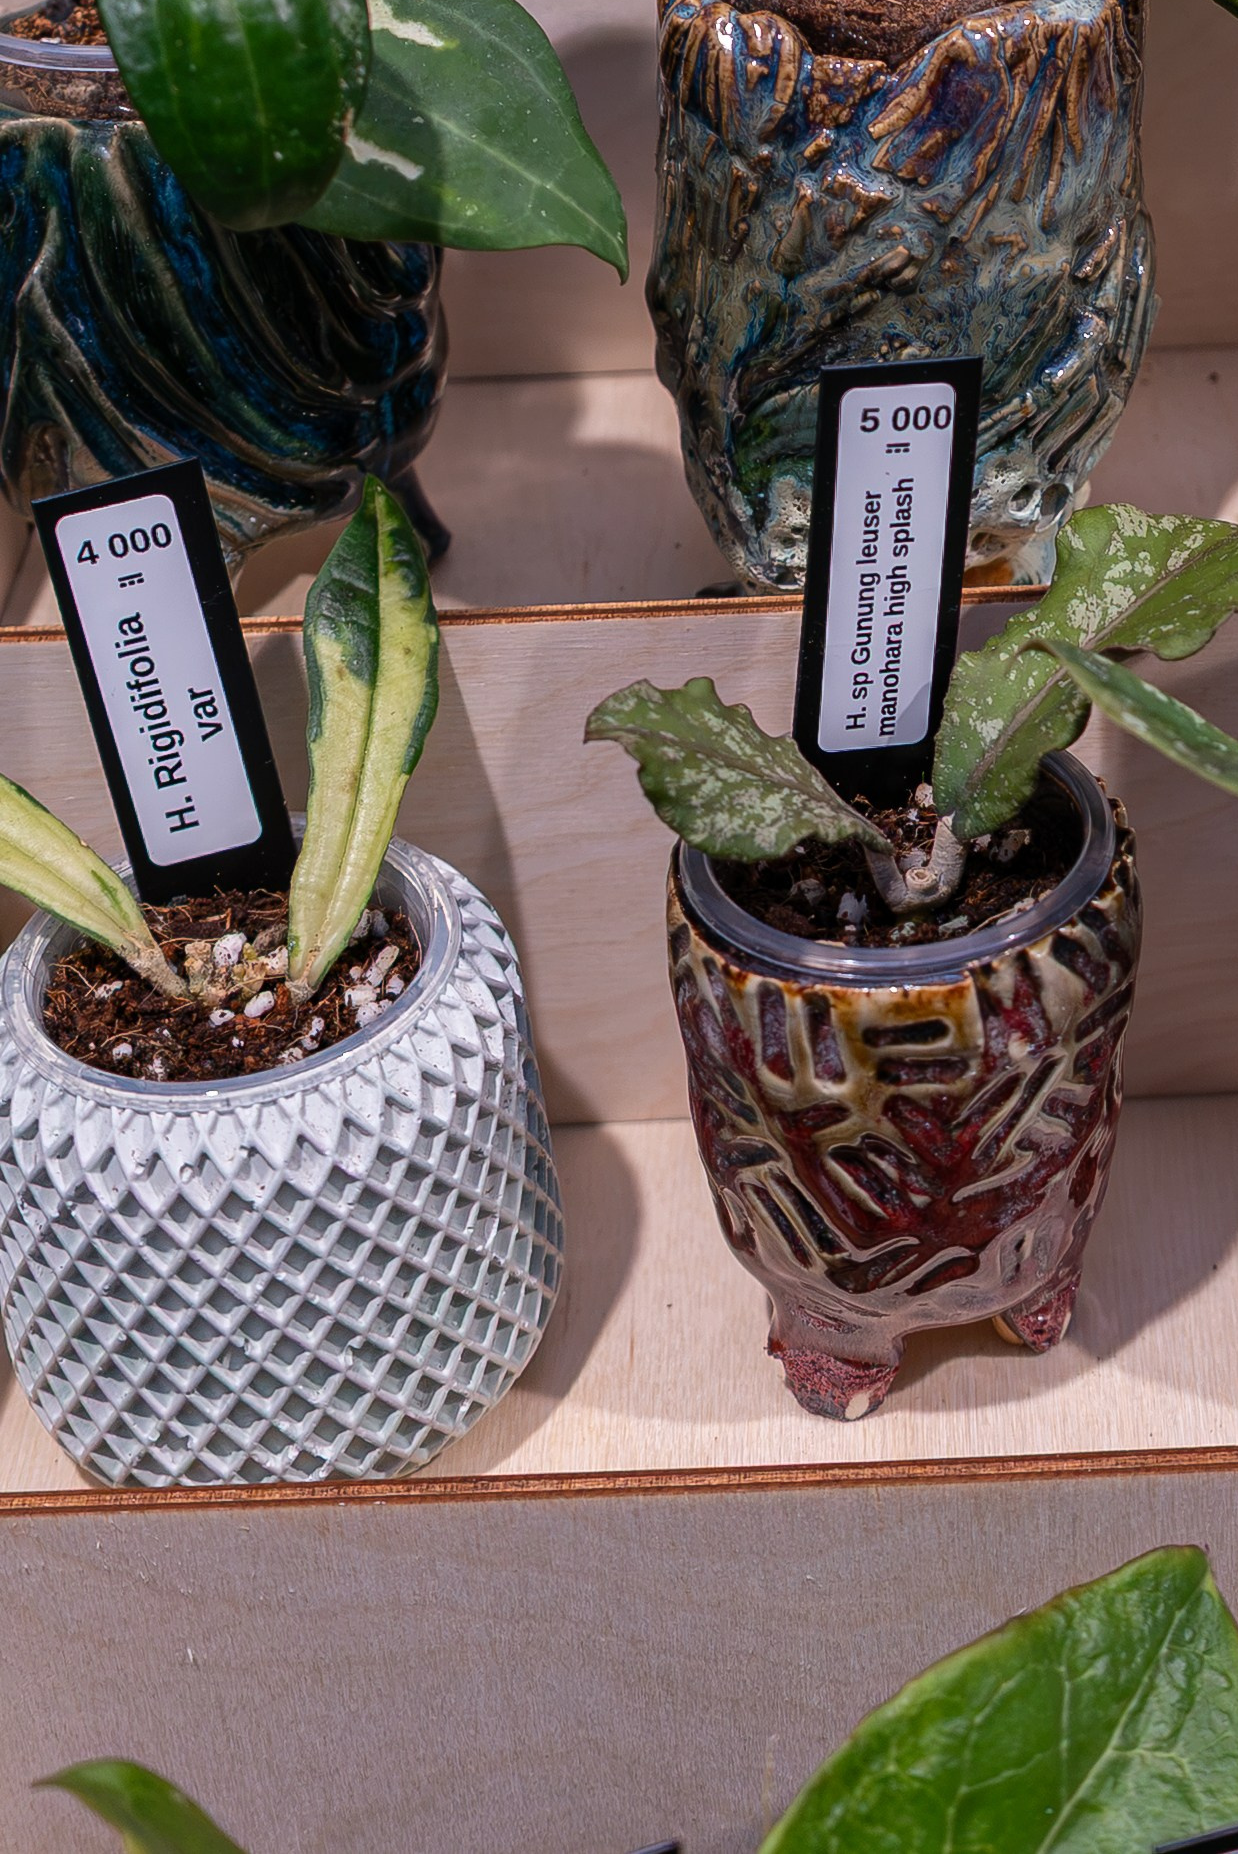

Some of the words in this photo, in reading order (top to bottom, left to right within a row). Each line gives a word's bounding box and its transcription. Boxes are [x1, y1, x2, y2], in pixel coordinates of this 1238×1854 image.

[860, 408, 880, 433] 5
[892, 405, 952, 432] 000
[77, 540, 99, 564] 4
[108, 523, 172, 558] 000
[856, 491, 881, 565] leuser
[889, 478, 914, 557] splash
[883, 565, 911, 616] high
[851, 573, 881, 665] Gunung
[115, 612, 187, 788] Rigidifolia
[852, 673, 874, 699] sp
[879, 621, 903, 738] manohara
[188, 688, 223, 742] var
[846, 707, 866, 730] H.
[165, 796, 199, 833] H.
